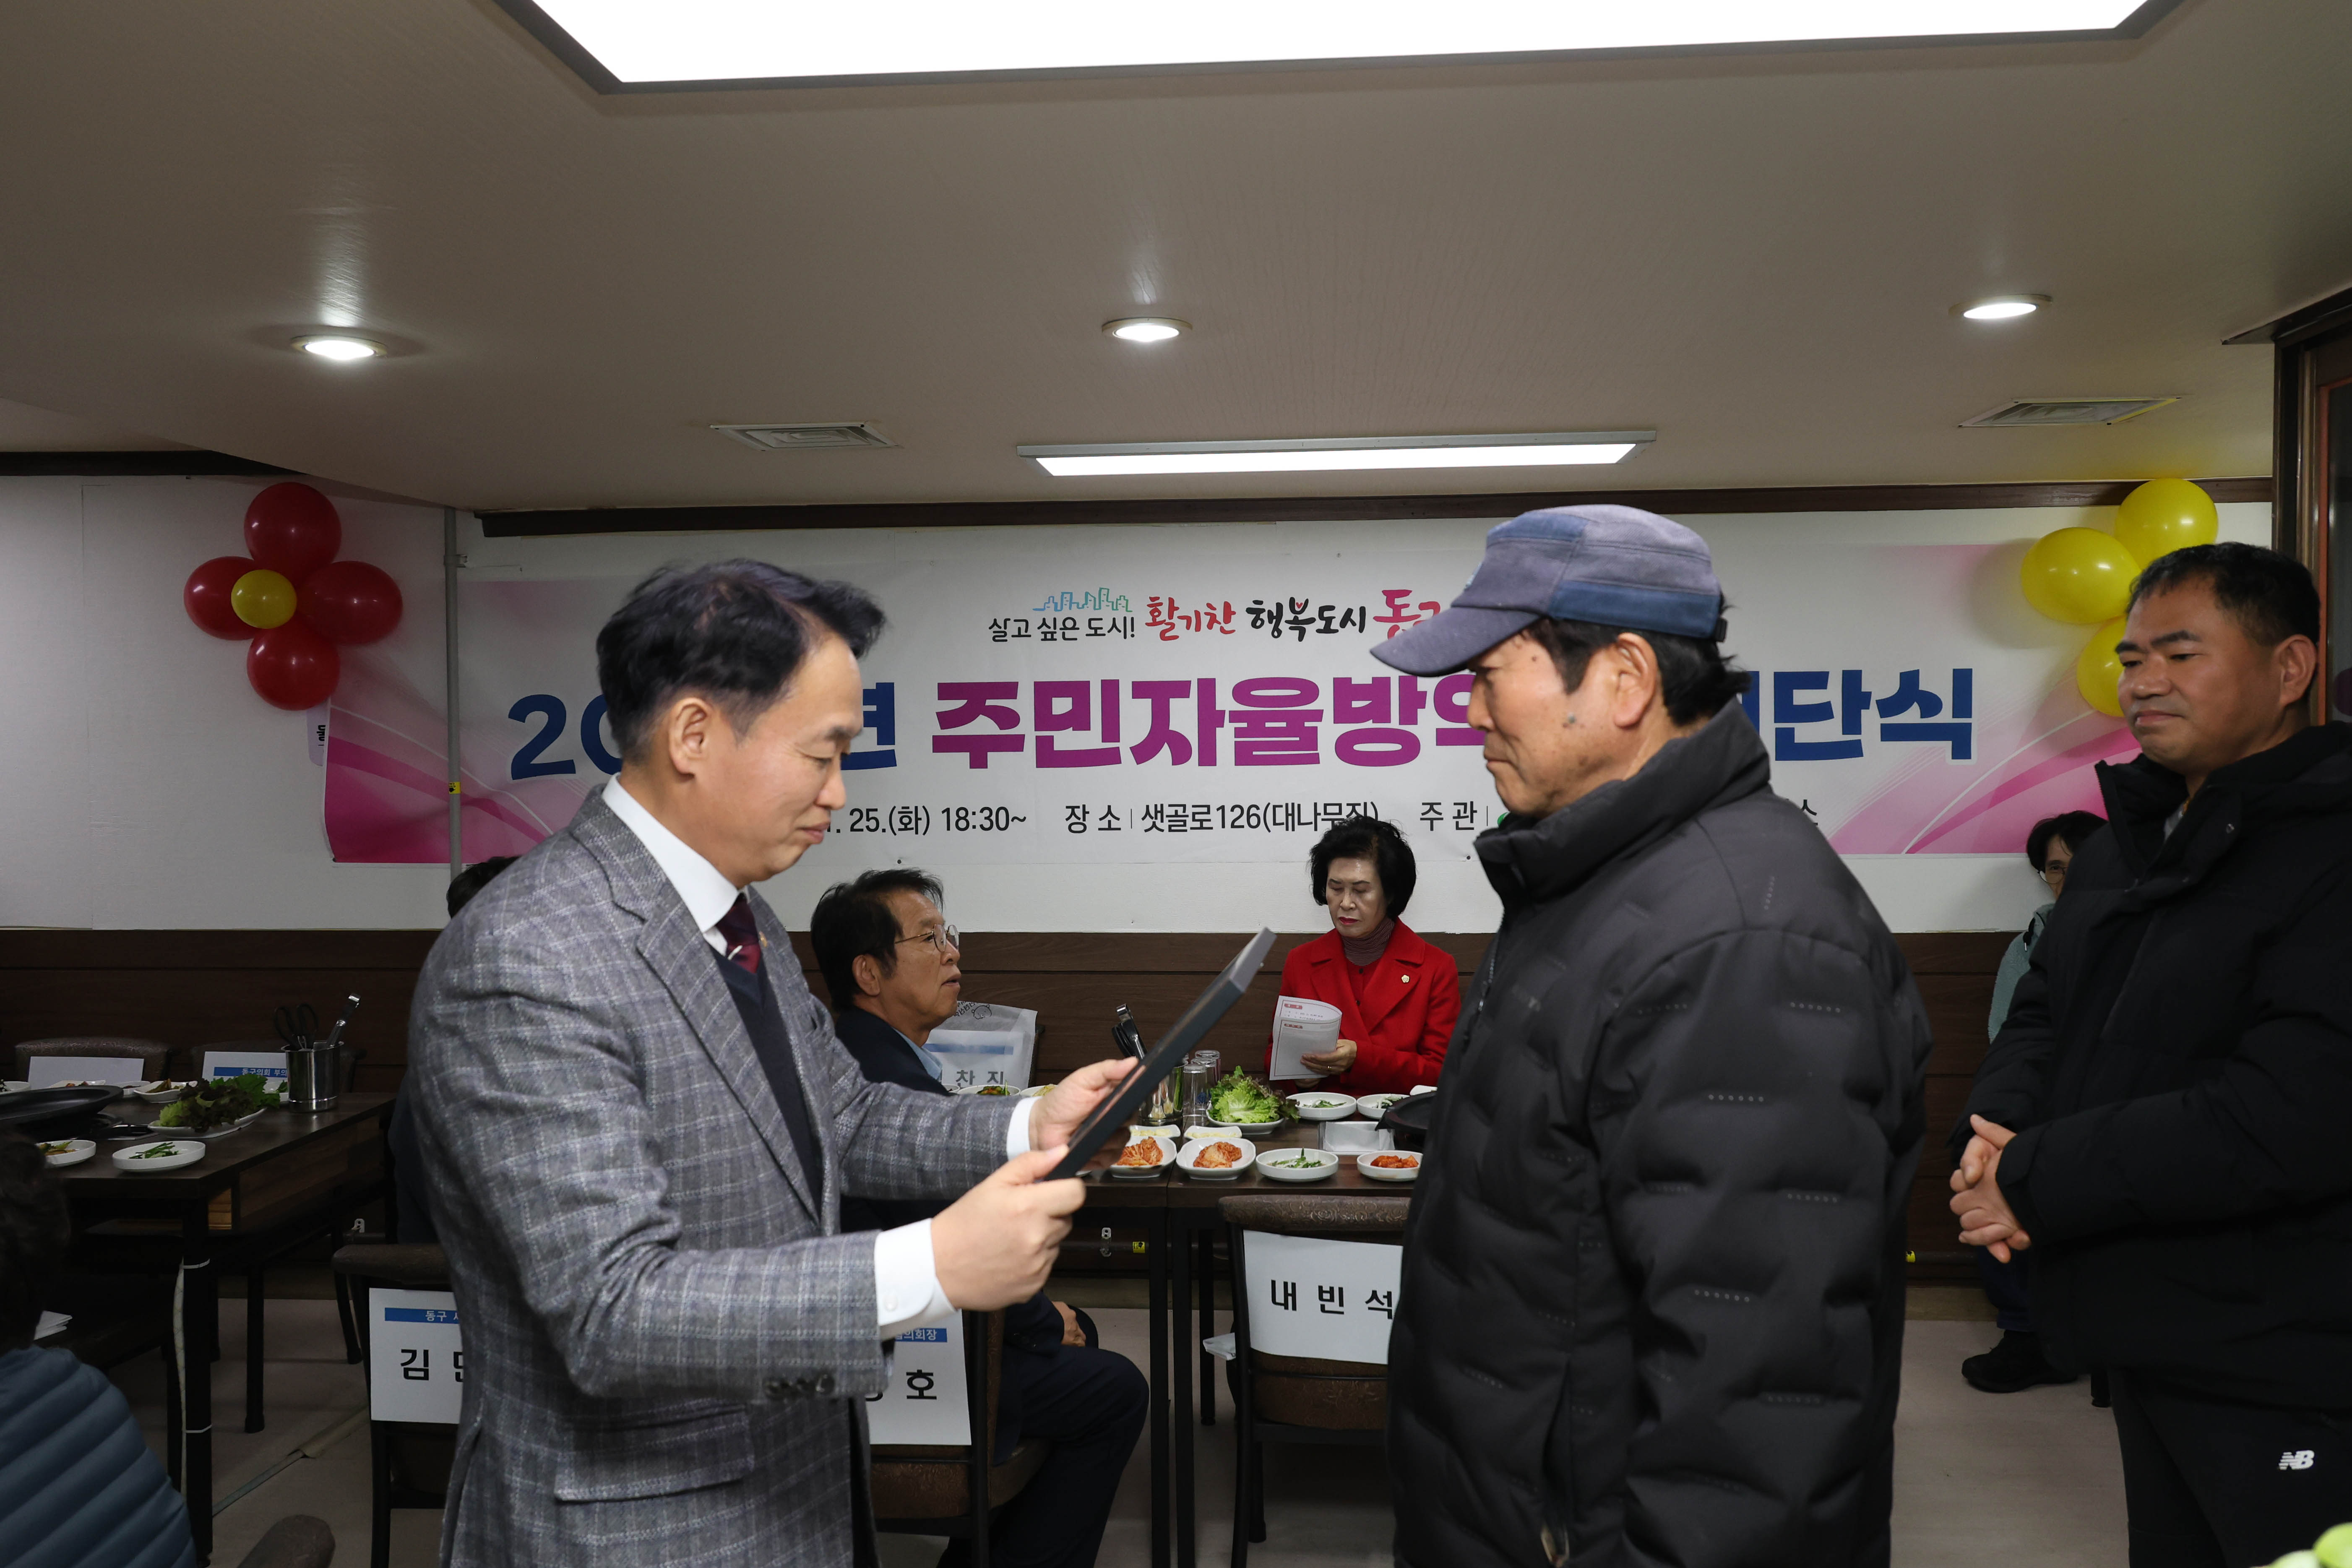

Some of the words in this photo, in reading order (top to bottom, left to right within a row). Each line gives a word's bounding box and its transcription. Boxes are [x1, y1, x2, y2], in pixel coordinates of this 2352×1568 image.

[988, 618, 1031, 642] 살고
[1037, 617, 1080, 641] 싶은
[1085, 616, 1135, 639] 도시!
[1145, 596, 1236, 641] 활기찬
[1245, 597, 1366, 642] 행복도시
[850, 805, 930, 836] 25.(화)
[941, 806, 1026, 831] 18:30~
[425, 1310, 447, 1322] 동구
[2279, 1450, 2315, 1470] NB
